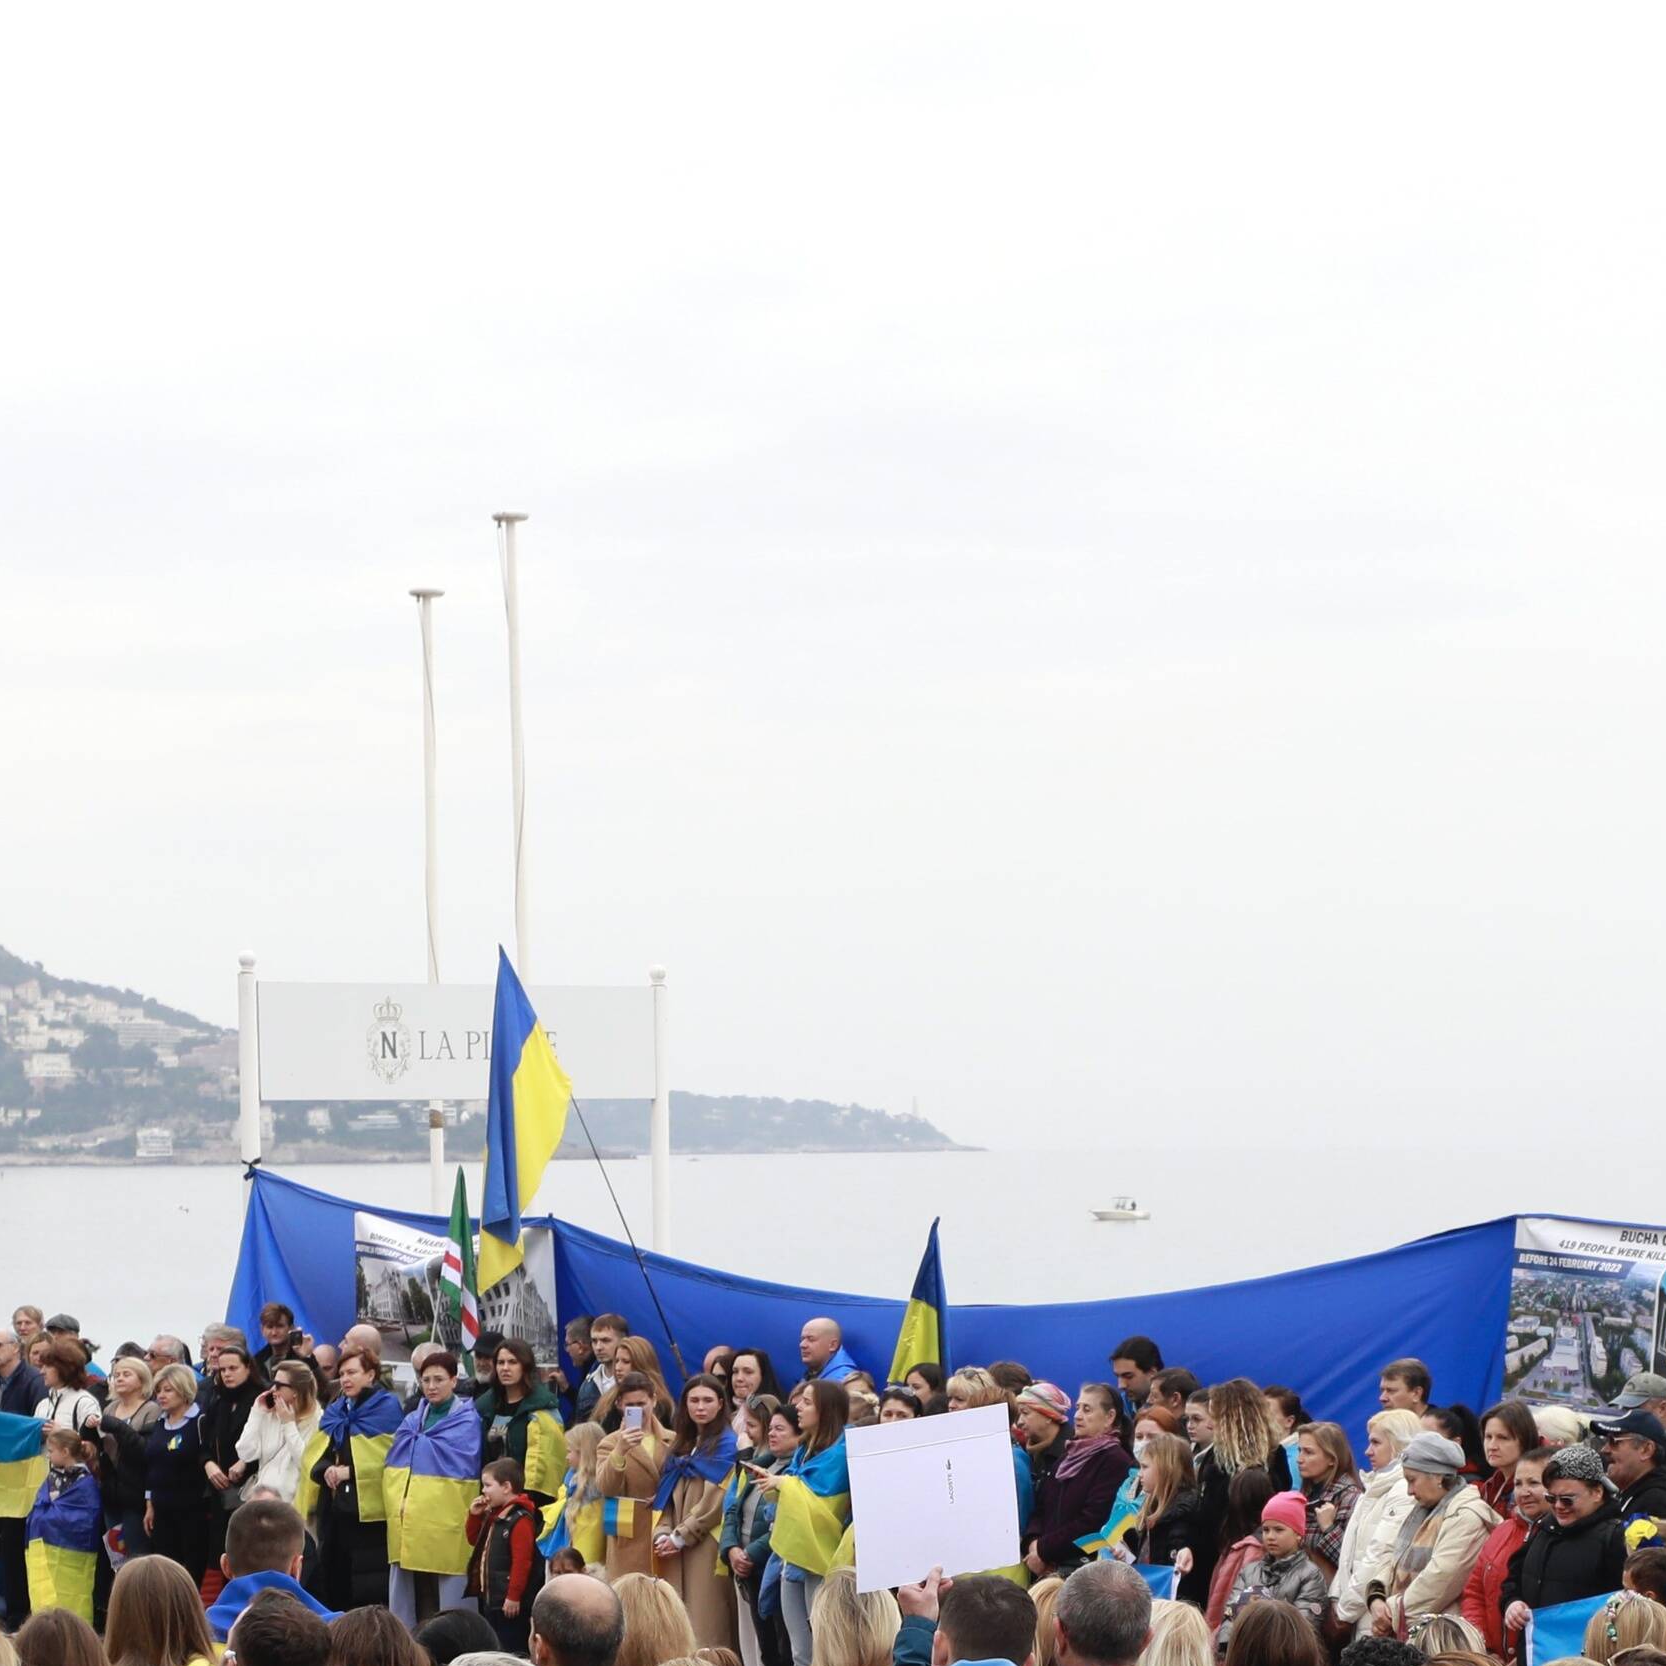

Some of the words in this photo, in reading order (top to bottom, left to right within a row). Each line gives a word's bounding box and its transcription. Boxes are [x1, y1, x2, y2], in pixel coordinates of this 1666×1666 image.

[380, 1030, 398, 1059] N
[418, 1030, 456, 1060] LA
[1620, 1230, 1659, 1246] BUCHA
[1559, 1239, 1576, 1250] 419
[1578, 1241, 1614, 1255] PEOPLE
[1618, 1247, 1645, 1259] WERE
[1519, 1253, 1548, 1265] BEFORE
[1549, 1256, 1559, 1266] 24
[1559, 1258, 1598, 1271] FEBRUARY
[1598, 1263, 1622, 1273] 2022
